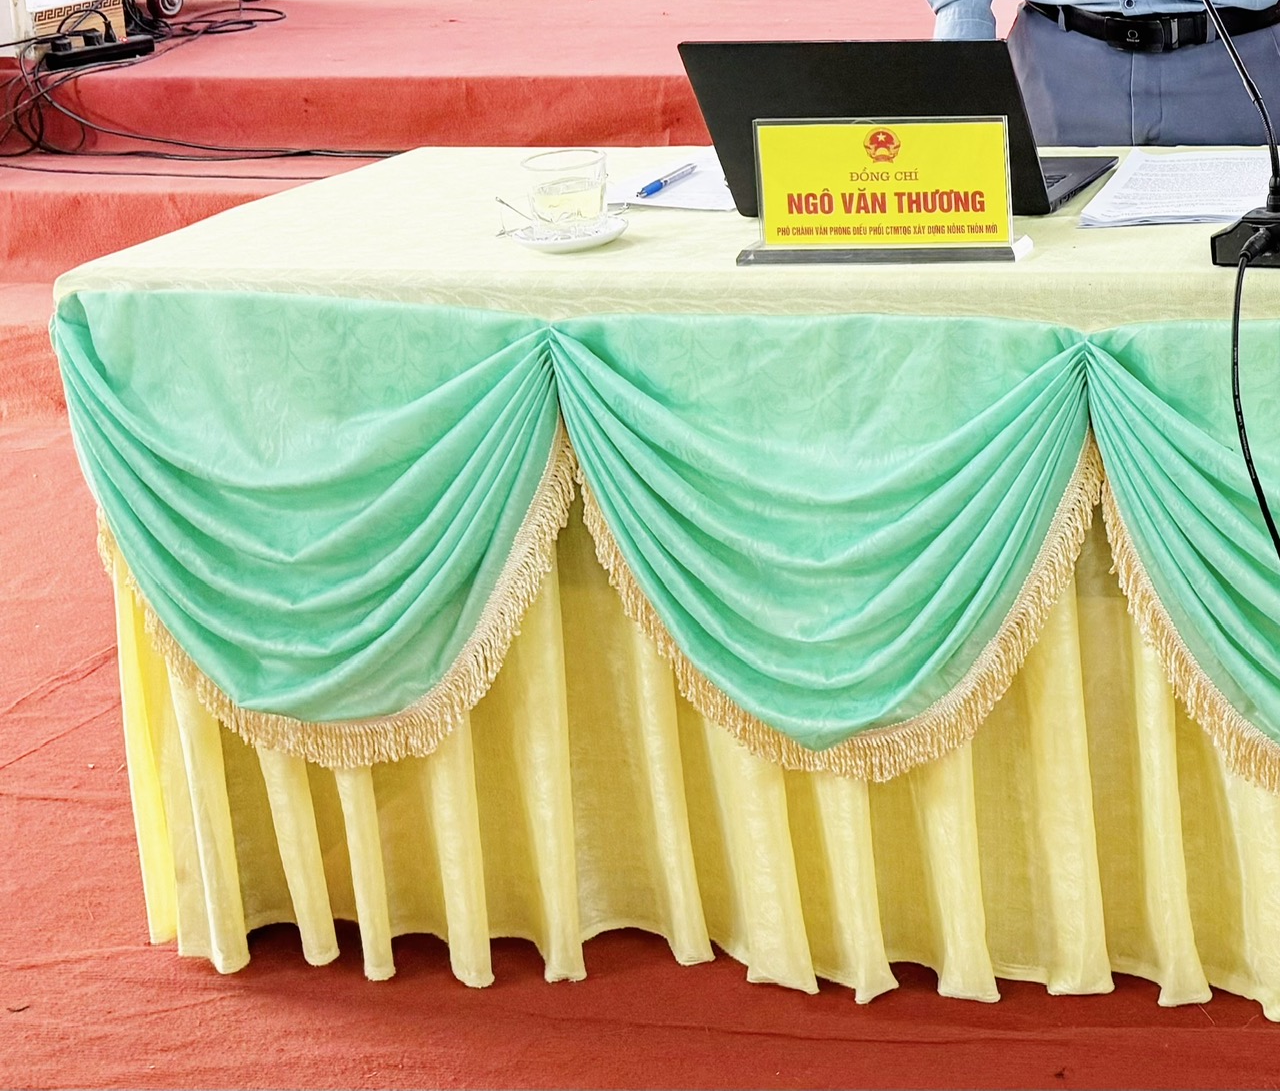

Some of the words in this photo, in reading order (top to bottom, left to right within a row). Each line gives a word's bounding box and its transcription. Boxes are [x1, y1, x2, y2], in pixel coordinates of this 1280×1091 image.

[850, 166, 890, 182] ĐỒNG
[894, 168, 919, 181] CHÍ
[787, 188, 833, 215] NGÔ
[841, 188, 886, 214] VĂN
[894, 189, 985, 213] THƯƠNG
